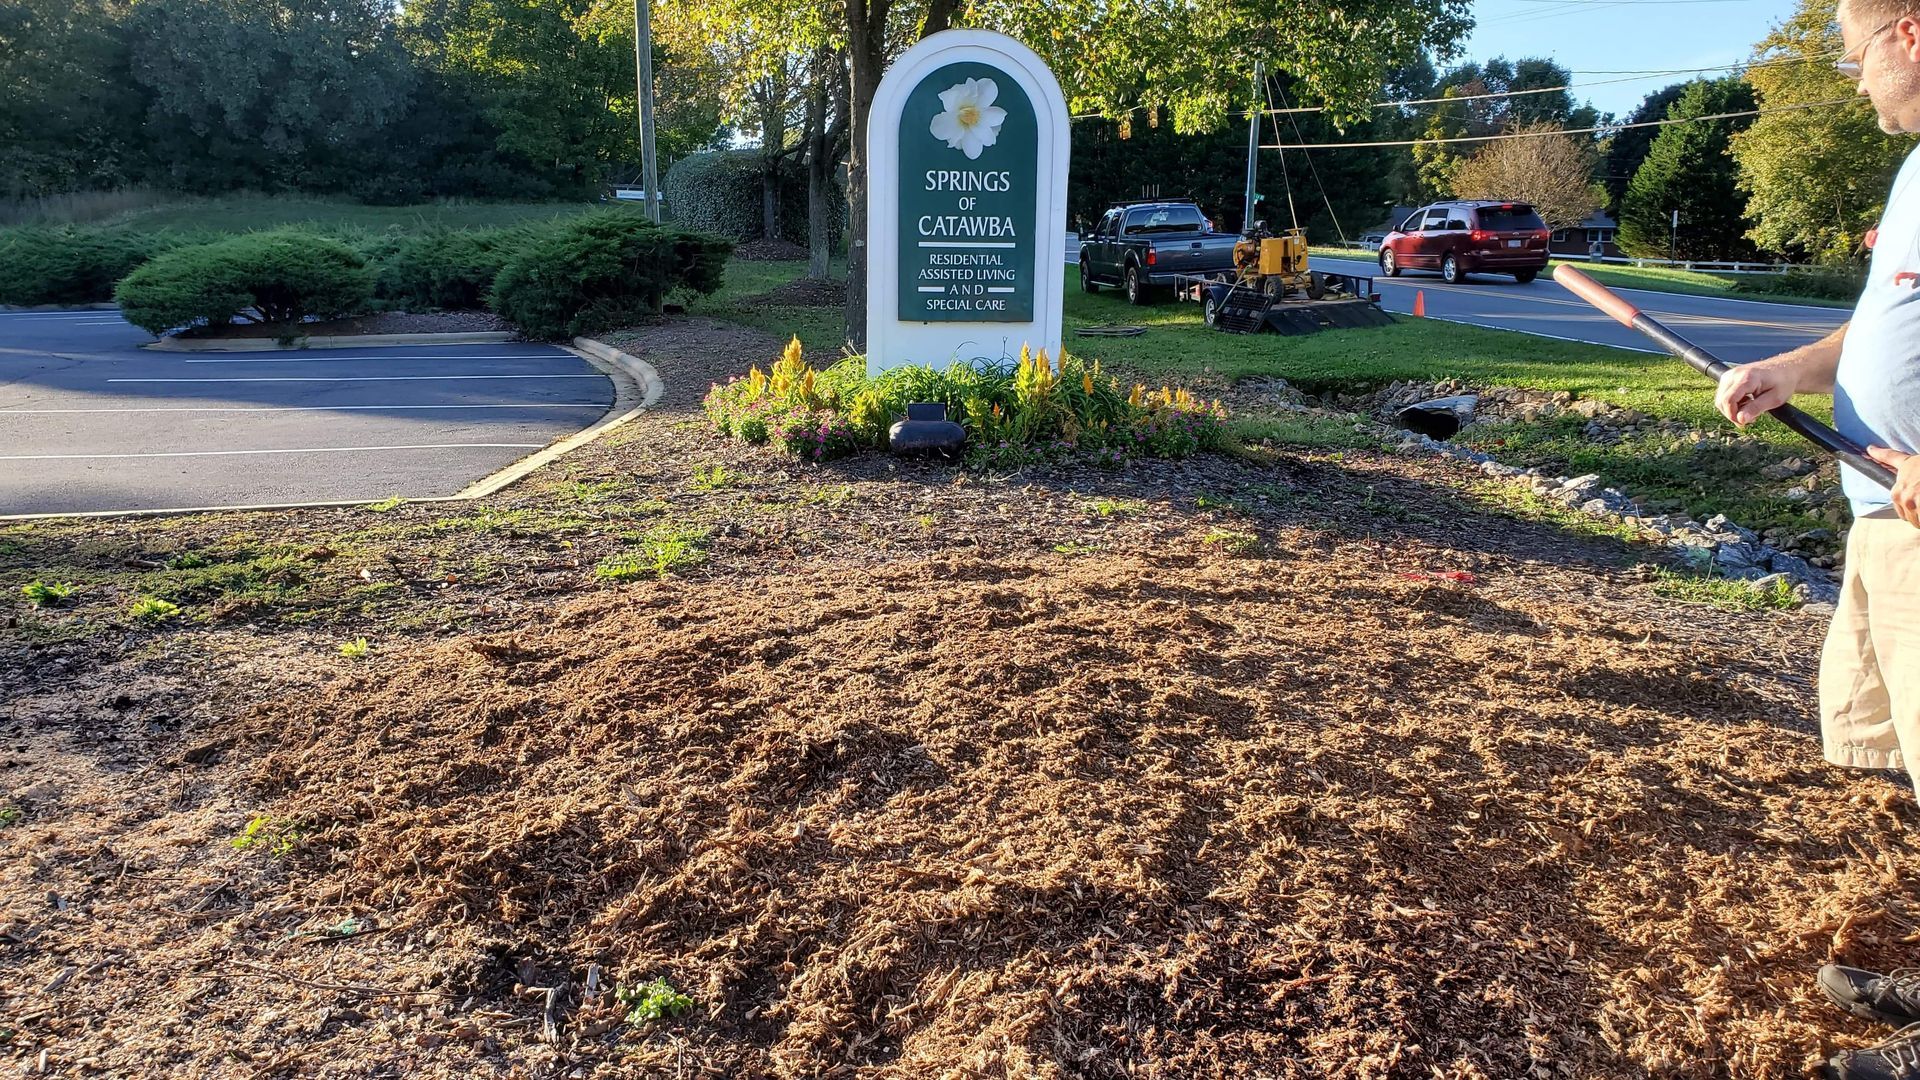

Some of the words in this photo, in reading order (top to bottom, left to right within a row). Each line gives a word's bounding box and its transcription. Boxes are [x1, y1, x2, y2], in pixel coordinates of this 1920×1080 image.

[925, 170, 1010, 192] SPRINGS
[958, 197, 977, 211] OF
[918, 215, 1016, 237] CATAWBA
[929, 254, 1004, 266] RESIDENTIAL
[918, 268, 974, 280] ASSISTED
[977, 269, 1015, 280] LIVING
[949, 284, 984, 296] AND
[926, 299, 972, 310] SPECIAL
[975, 299, 1006, 311] CARE
